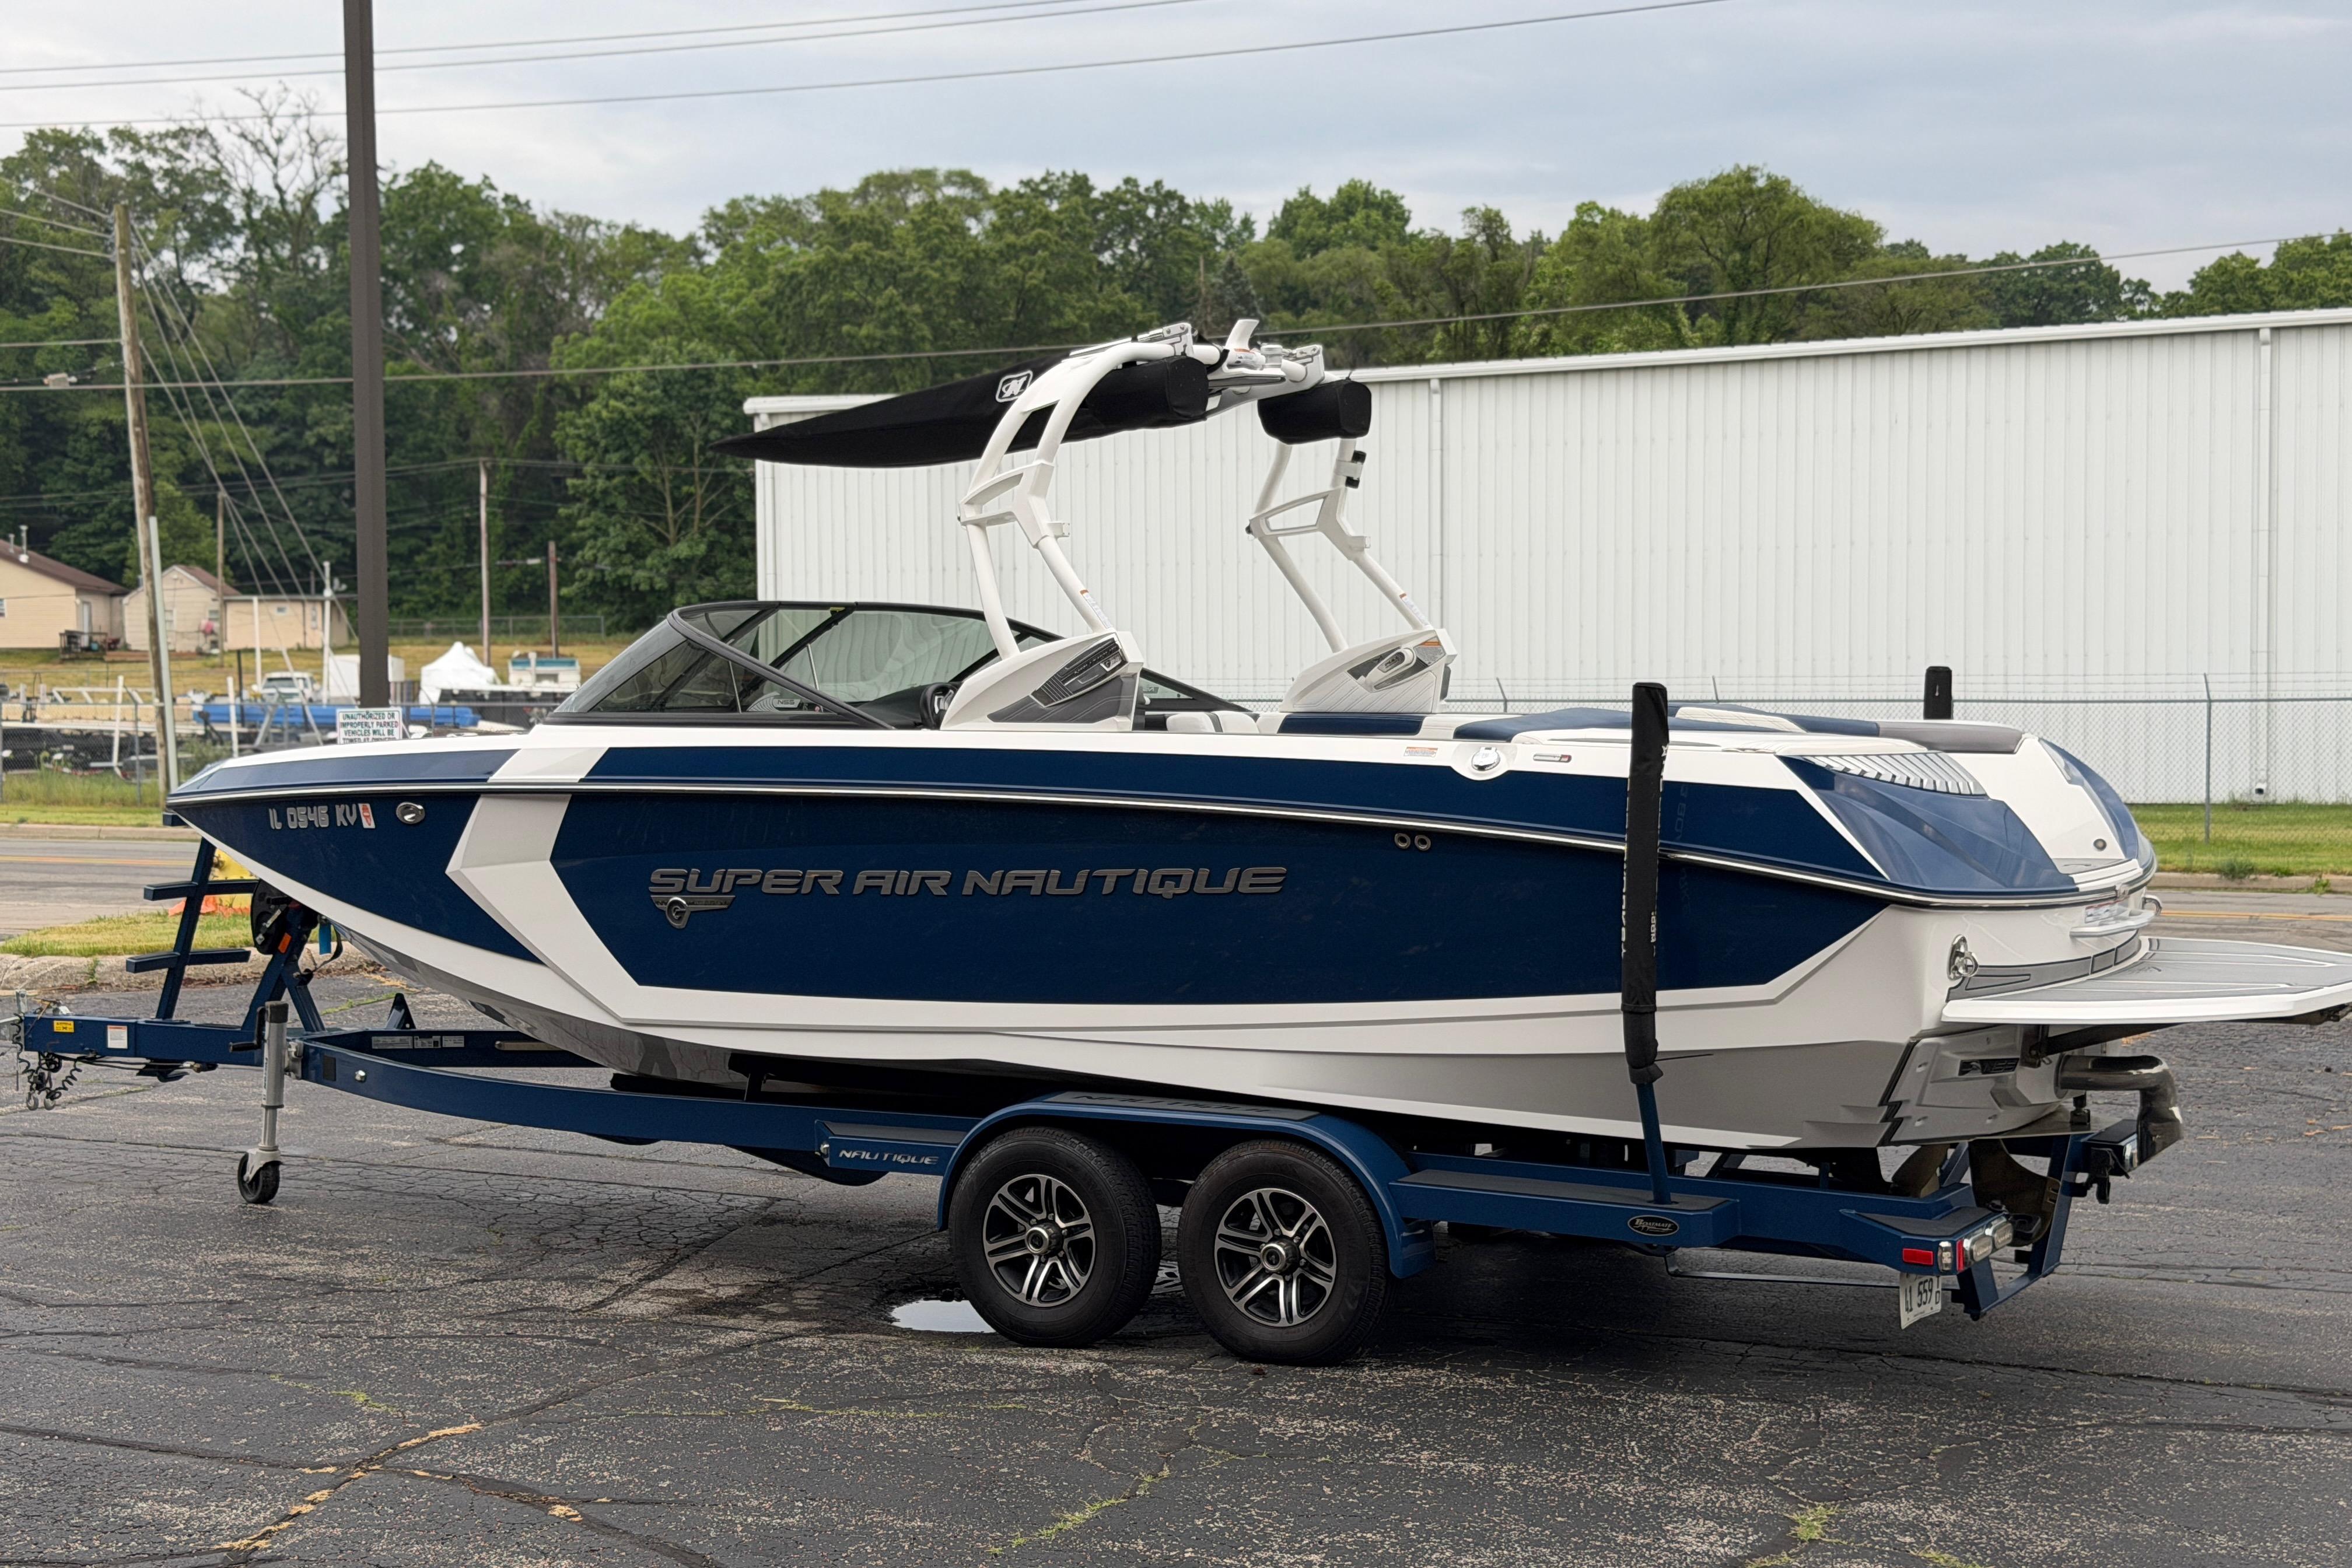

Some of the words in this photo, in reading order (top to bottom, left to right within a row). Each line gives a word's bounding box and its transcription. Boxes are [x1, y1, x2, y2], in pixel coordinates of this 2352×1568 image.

[342, 712, 386, 720] UNAUTHORIZED
[268, 808, 282, 830] IL
[286, 805, 330, 829] 0546
[335, 803, 358, 827] KV
[648, 869, 844, 895] SUPER
[852, 869, 952, 896] AIR
[961, 867, 1287, 899] NAUTIQUE
[838, 1150, 940, 1165] NAUTIQUE
[1917, 1278, 1933, 1308] 559
